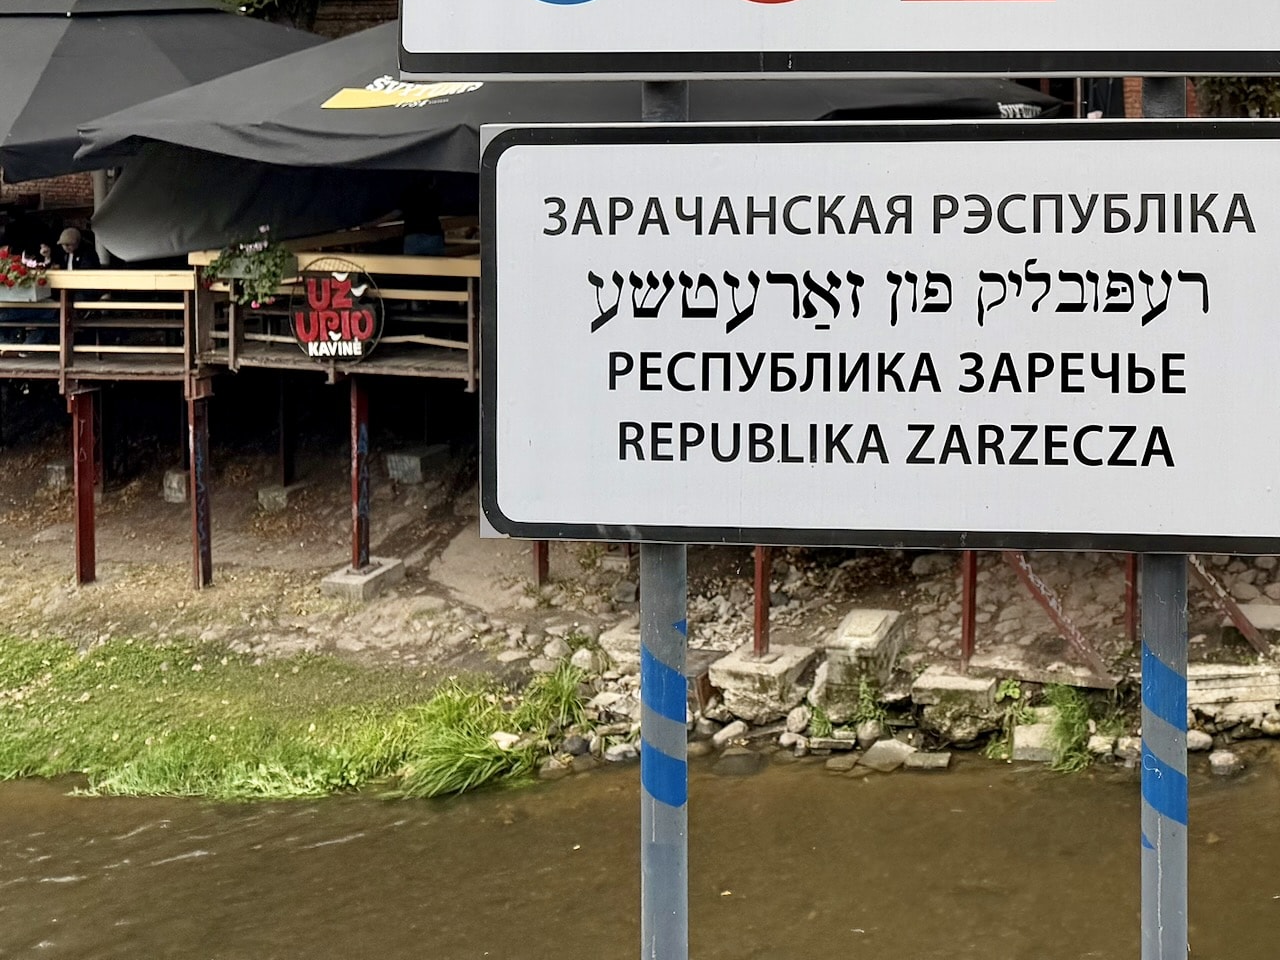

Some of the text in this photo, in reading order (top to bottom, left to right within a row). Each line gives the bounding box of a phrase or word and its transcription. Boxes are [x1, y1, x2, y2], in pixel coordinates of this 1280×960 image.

[543, 193, 1256, 236] ЗАРАЧАНСКАЯ РЭСПУБЛІКА
[886, 270, 953, 327] פון
[295, 309, 374, 343] UPIO
[308, 337, 362, 357] KAVINĖ
[608, 351, 1187, 394] РЕСПУБЛИКА ЗАРЕЧЬЕ
[619, 421, 1175, 468] REPUBLIKA ZARZECZA
